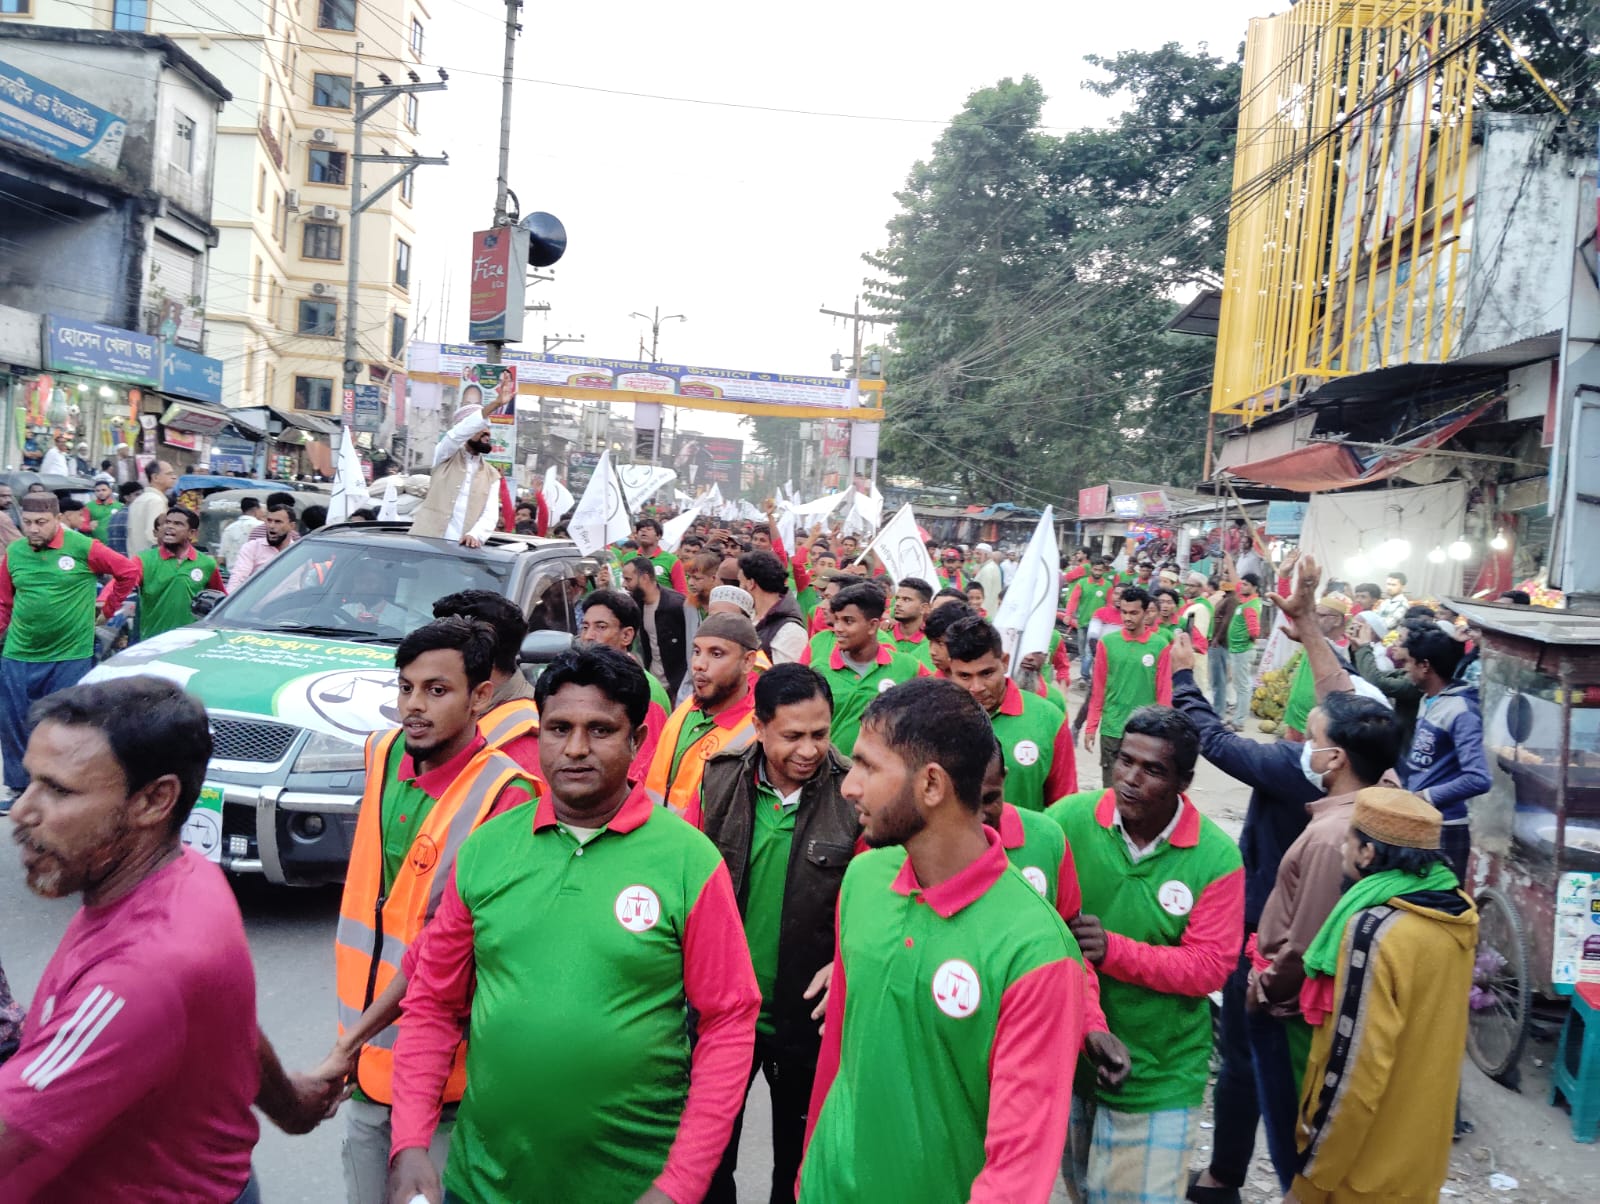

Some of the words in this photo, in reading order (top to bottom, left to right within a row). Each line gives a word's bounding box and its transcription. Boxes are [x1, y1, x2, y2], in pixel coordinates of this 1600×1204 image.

[58, 327, 102, 350] হোসেন
[104, 337, 132, 357] খেলা
[134, 342, 152, 360] ঘর
